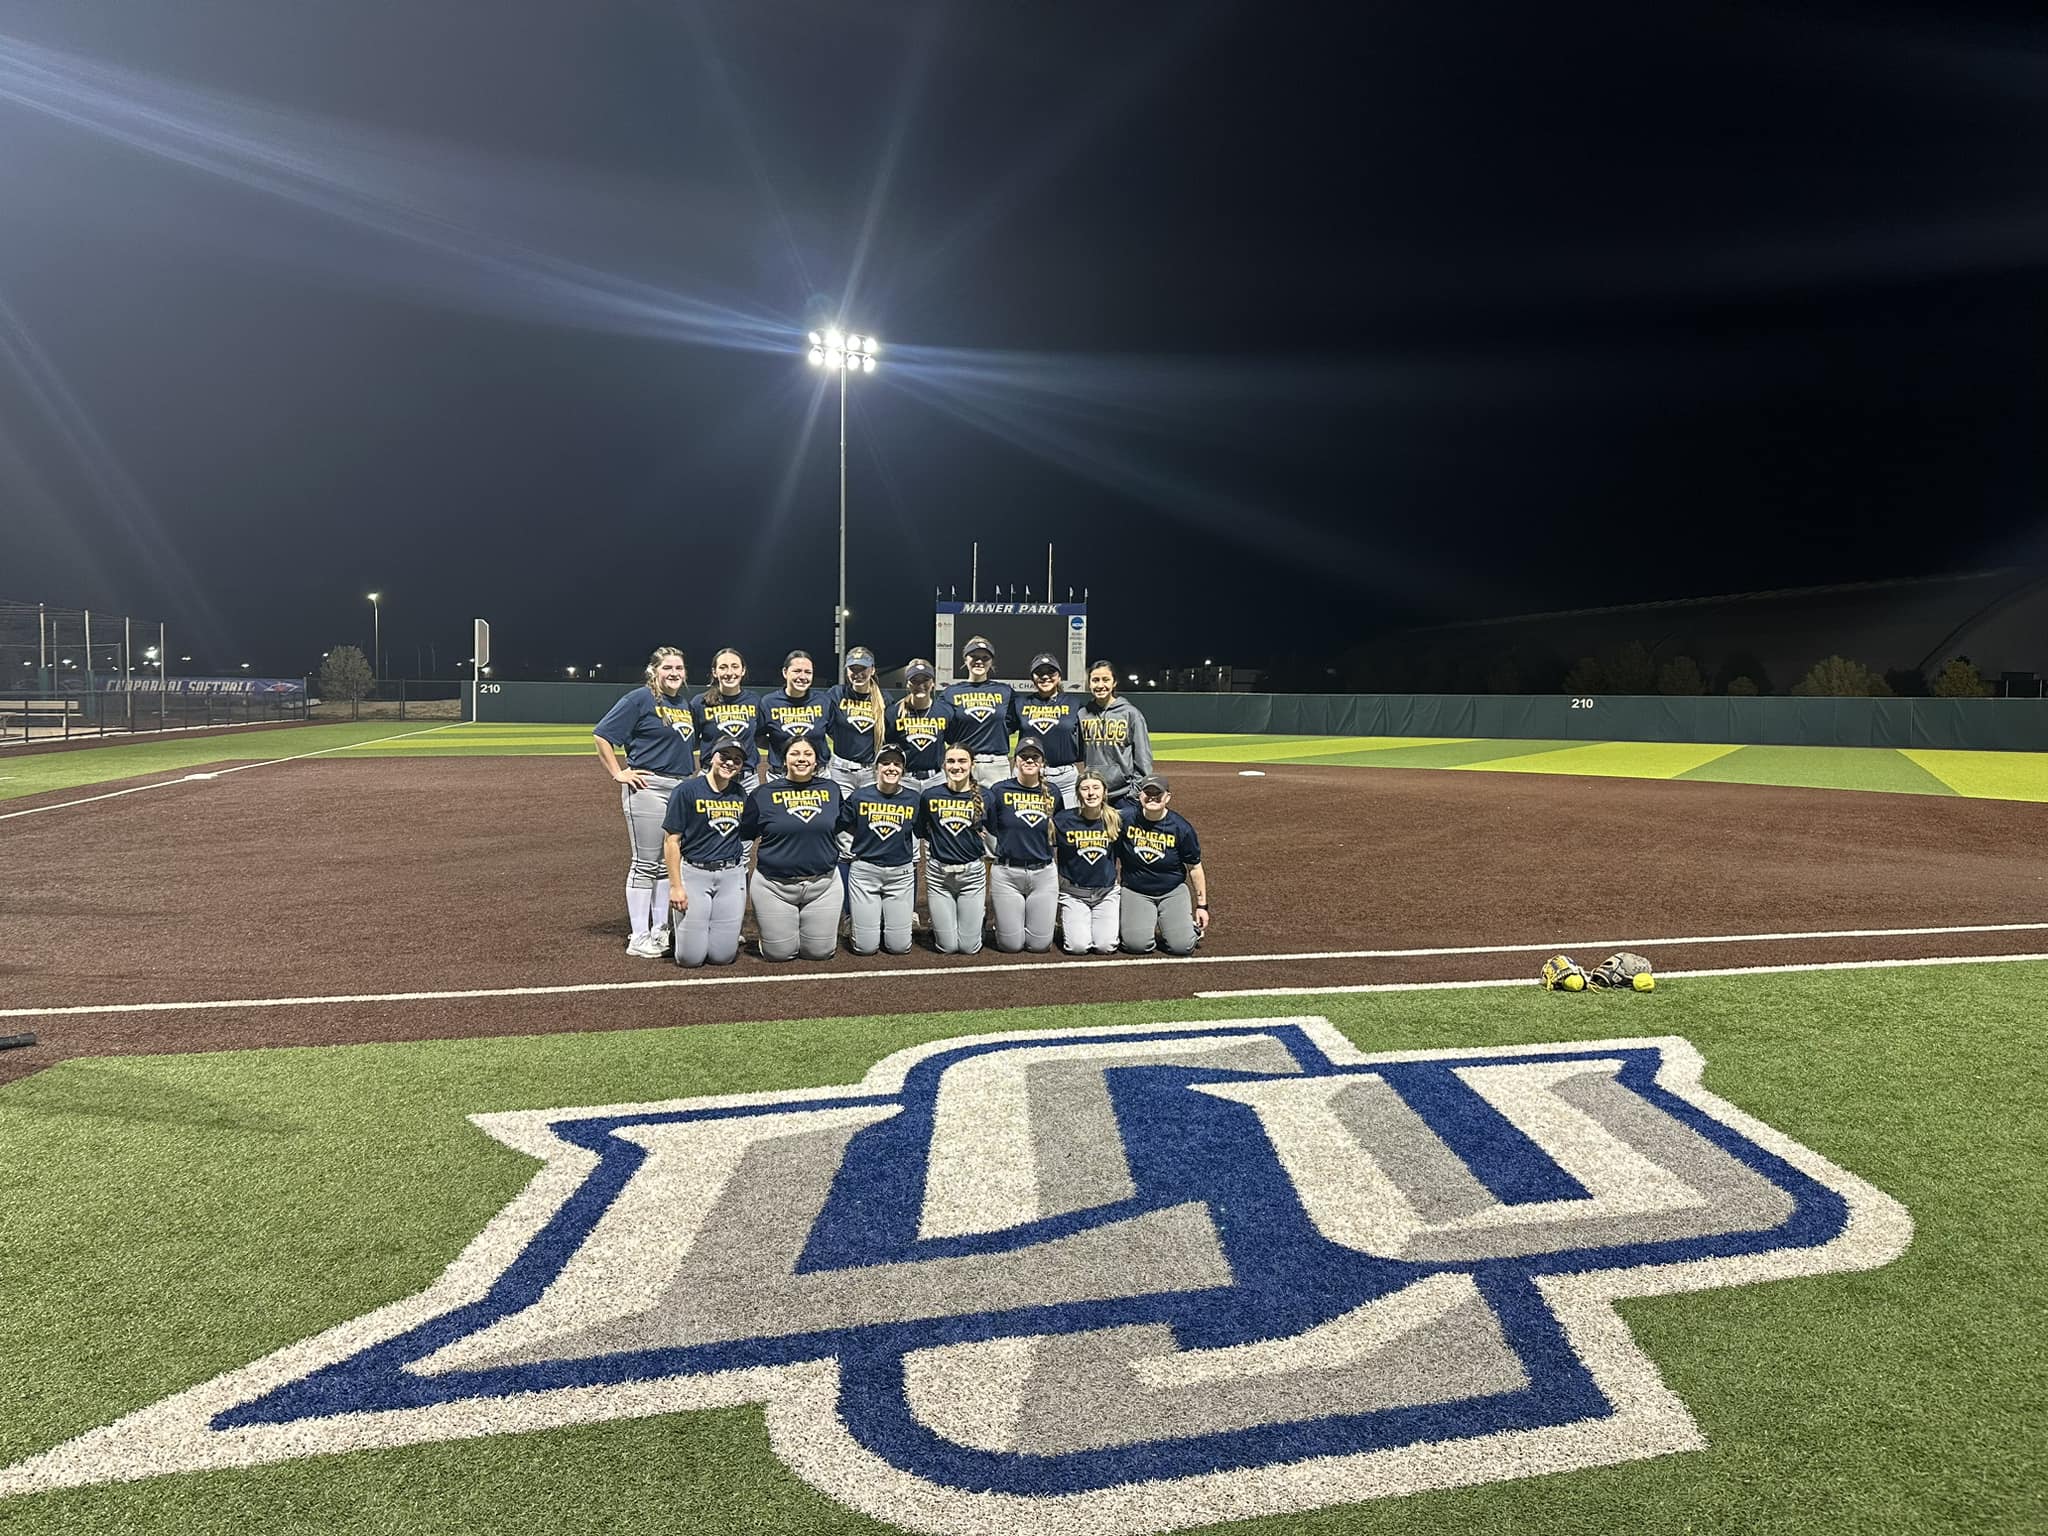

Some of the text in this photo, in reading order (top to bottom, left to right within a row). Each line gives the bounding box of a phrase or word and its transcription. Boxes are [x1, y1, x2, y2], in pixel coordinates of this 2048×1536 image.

[962, 603, 1058, 614] MANER PARK
[188, 681, 254, 695] SOFTBALL
[480, 684, 500, 693] 210
[840, 698, 873, 710] COUG
[954, 692, 1003, 706] COUGAR
[1571, 698, 1594, 709] 210
[704, 705, 756, 720] COUGAR
[771, 705, 822, 720] COUGAR
[1022, 705, 1070, 715] COUGAR
[896, 717, 946, 731] COUGAR
[1081, 718, 1128, 741] WNCC
[771, 789, 830, 804] COUGAR
[788, 799, 818, 808] SOFTBALL
[929, 799, 974, 812] COUGA
[710, 810, 738, 819] SOFTBALL
[859, 802, 914, 820] COUGAR
[941, 809, 970, 818] SOFTBALL
[871, 814, 900, 823] SOFTBALL
[1066, 830, 1109, 844] COUGA
[1078, 839, 1106, 848] SOFTBALL
[1127, 826, 1176, 848] COUGAR
